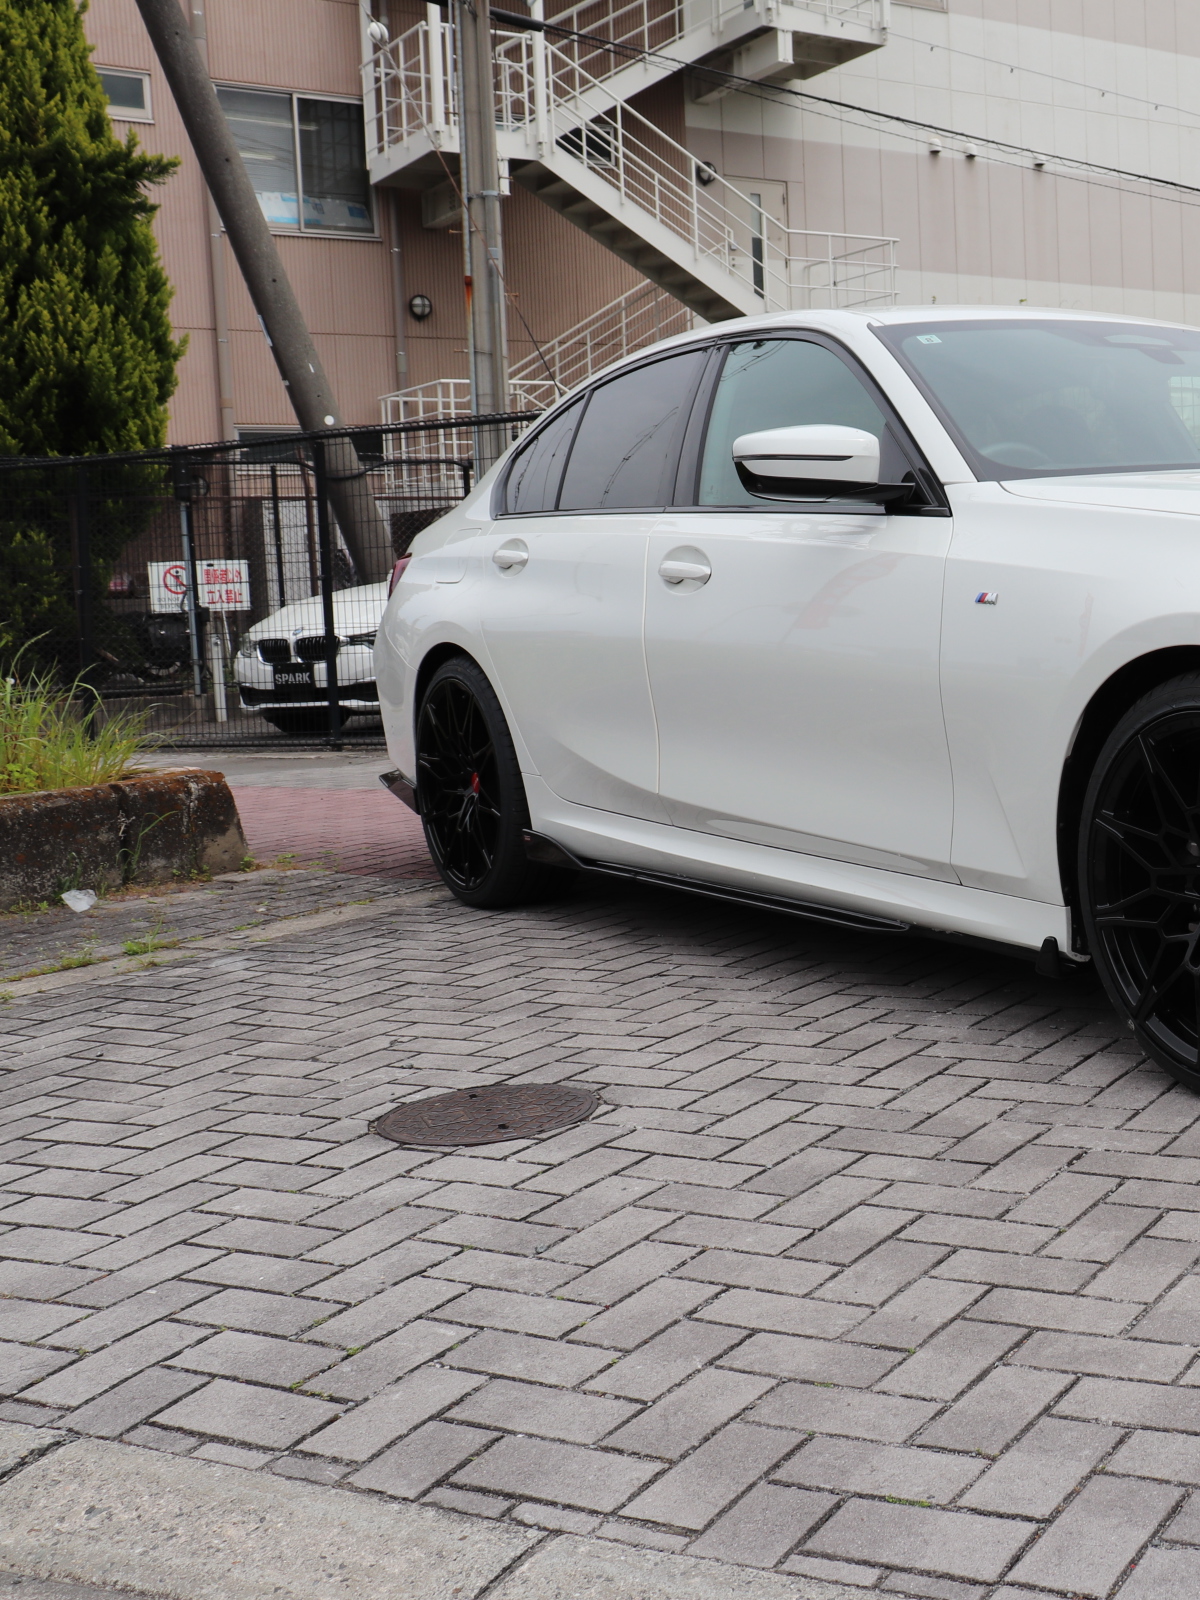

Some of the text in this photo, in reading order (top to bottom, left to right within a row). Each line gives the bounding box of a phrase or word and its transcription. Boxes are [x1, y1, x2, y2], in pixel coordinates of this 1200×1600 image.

[207, 589, 242, 604] 立入禁止
[275, 672, 311, 684] SPARK
